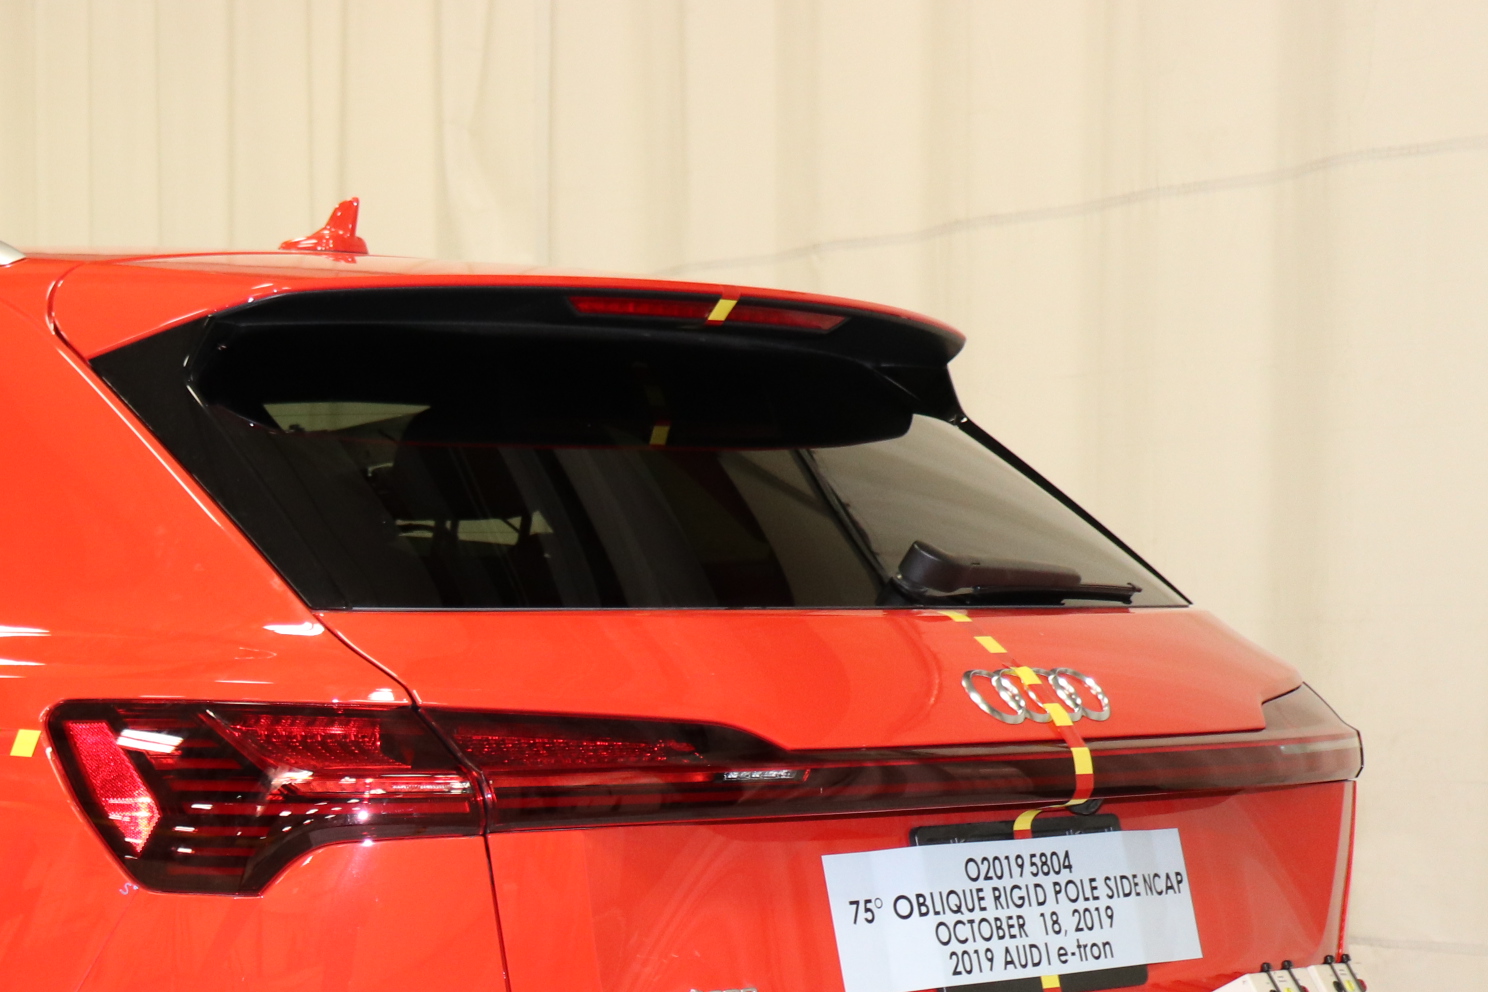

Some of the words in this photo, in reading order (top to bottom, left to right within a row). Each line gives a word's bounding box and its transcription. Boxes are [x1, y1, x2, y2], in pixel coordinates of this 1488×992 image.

[893, 887, 988, 920] OBLIQUE
[991, 883, 1047, 911] RIGID
[1052, 877, 1100, 904] POLE
[1103, 873, 1141, 900] SIDE
[1142, 871, 1184, 897] NCAP
[935, 914, 1029, 947] OCTOBER
[1039, 910, 1068, 938] 18,
[1072, 905, 1114, 933] 2019
[949, 947, 994, 976] 2019
[1003, 942, 1051, 970] AUDI
[1057, 938, 1114, 965] e-tron
